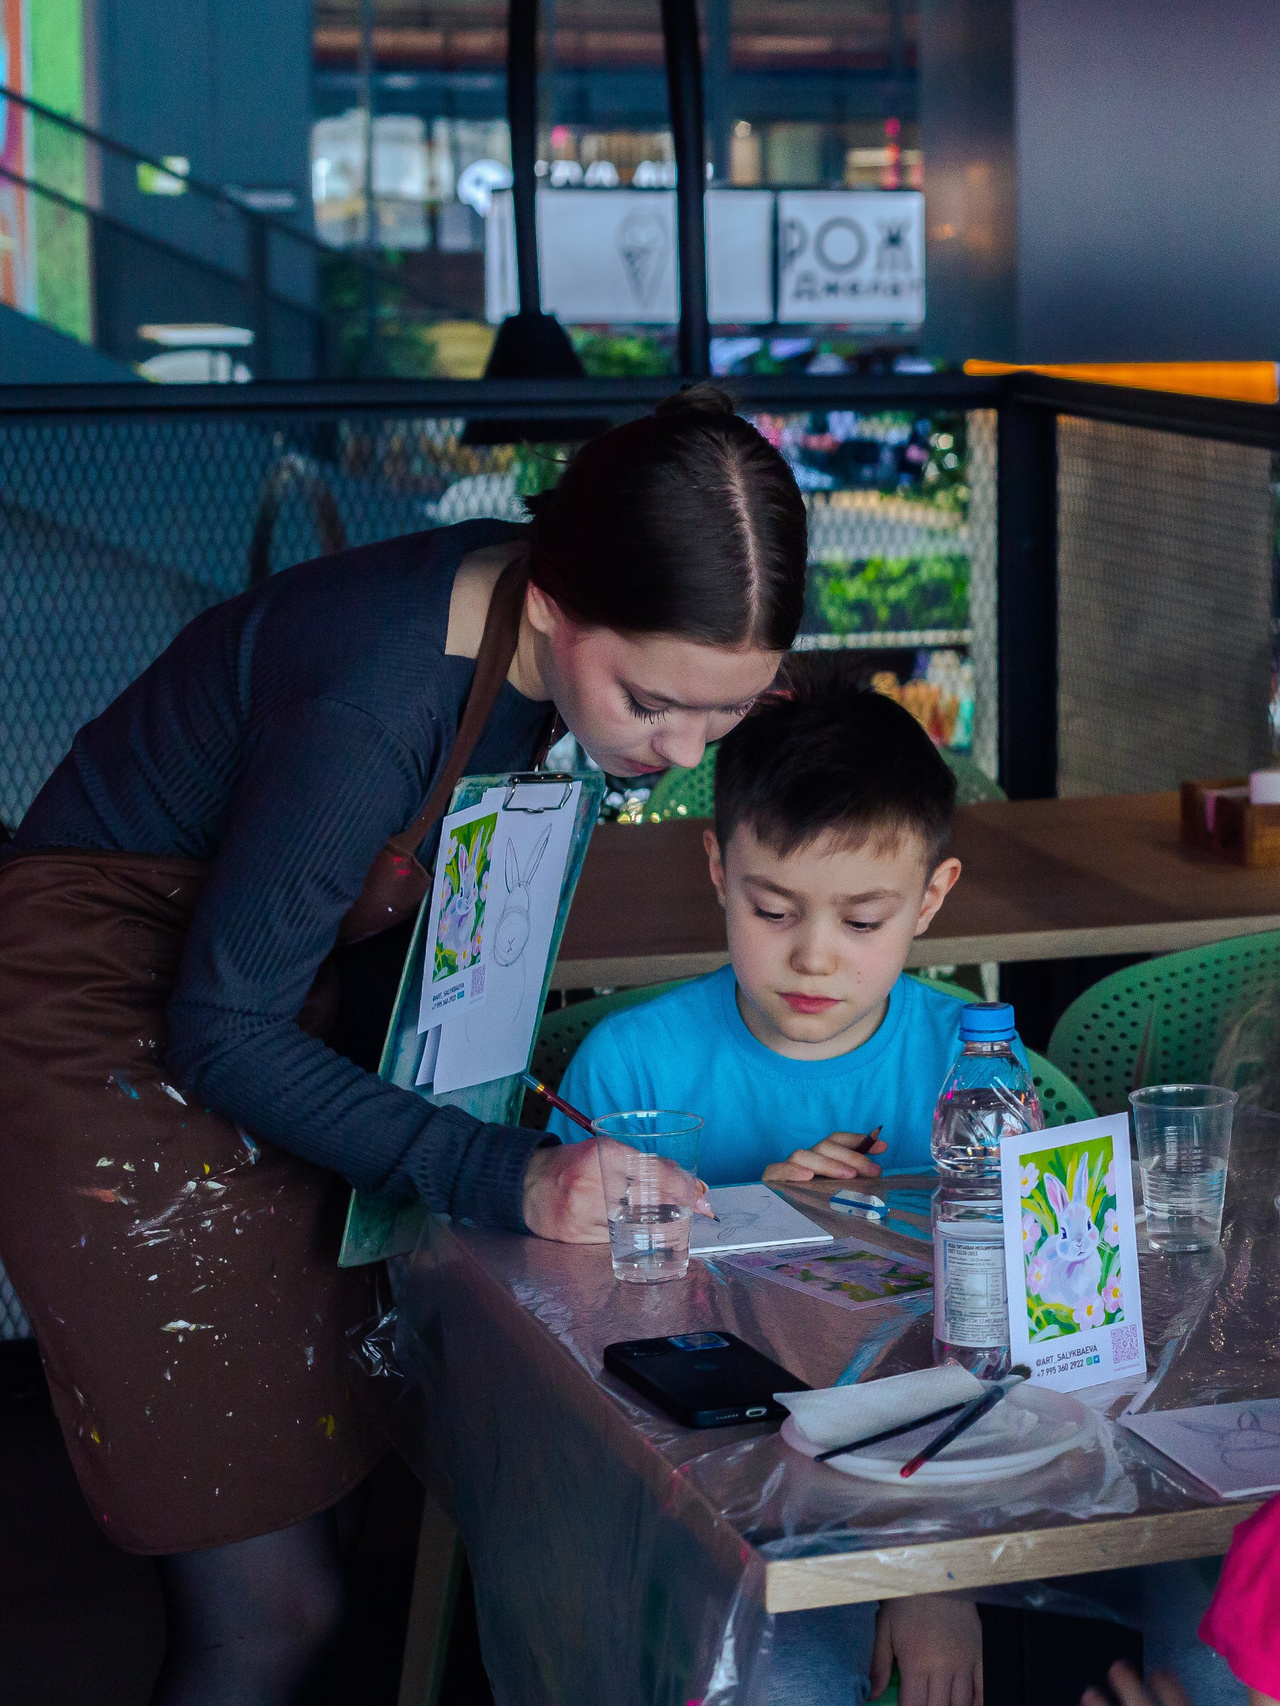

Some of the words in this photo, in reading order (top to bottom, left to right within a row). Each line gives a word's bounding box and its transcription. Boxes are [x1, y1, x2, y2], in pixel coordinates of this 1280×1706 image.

[1046, 1366, 1056, 1376] 995
[1058, 1363, 1068, 1374] 360
[1070, 1359, 1084, 1370] 2922
